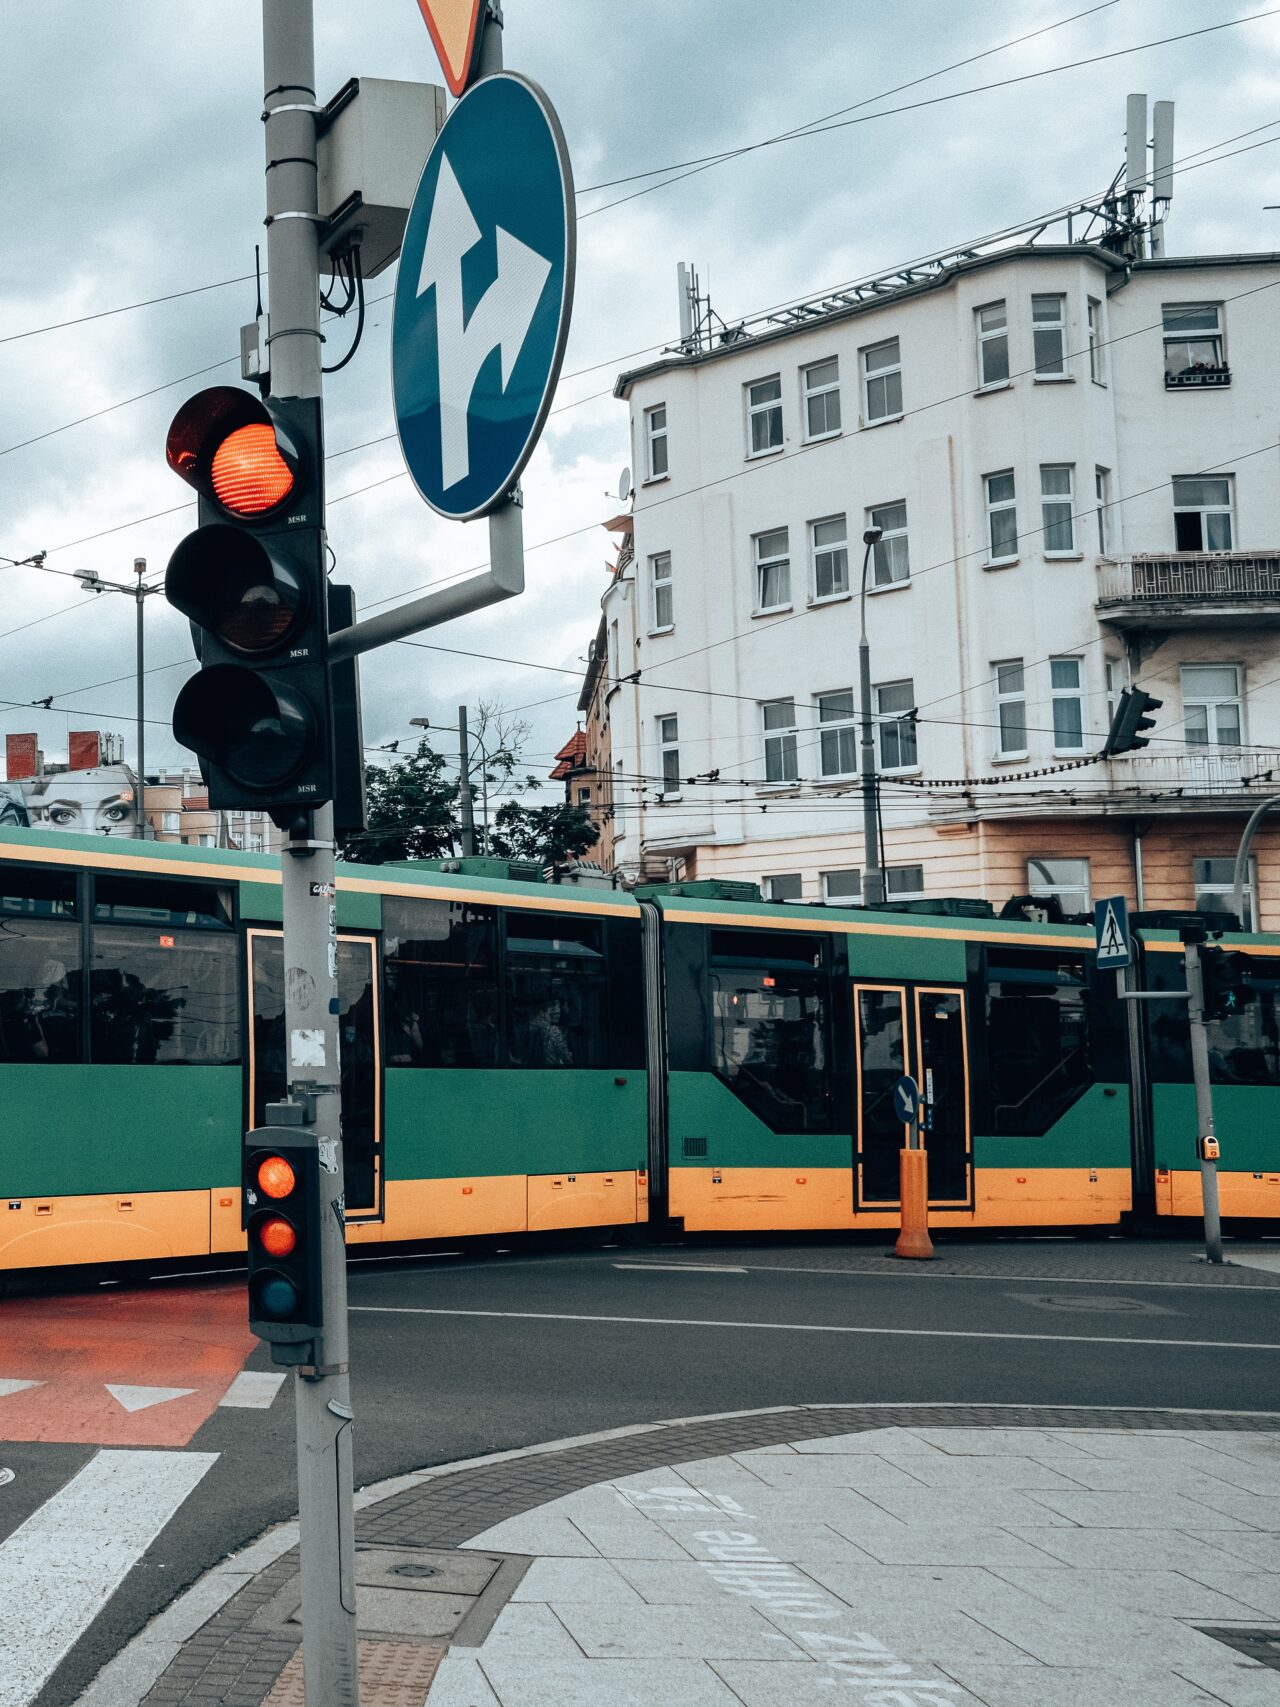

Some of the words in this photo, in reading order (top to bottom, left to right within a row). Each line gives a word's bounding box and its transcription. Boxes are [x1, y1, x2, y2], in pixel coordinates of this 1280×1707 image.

[288, 515, 306, 524] MSR
[290, 649, 308, 658] MSR
[298, 784, 317, 793] MSR
[694, 1529, 843, 1619] offline
